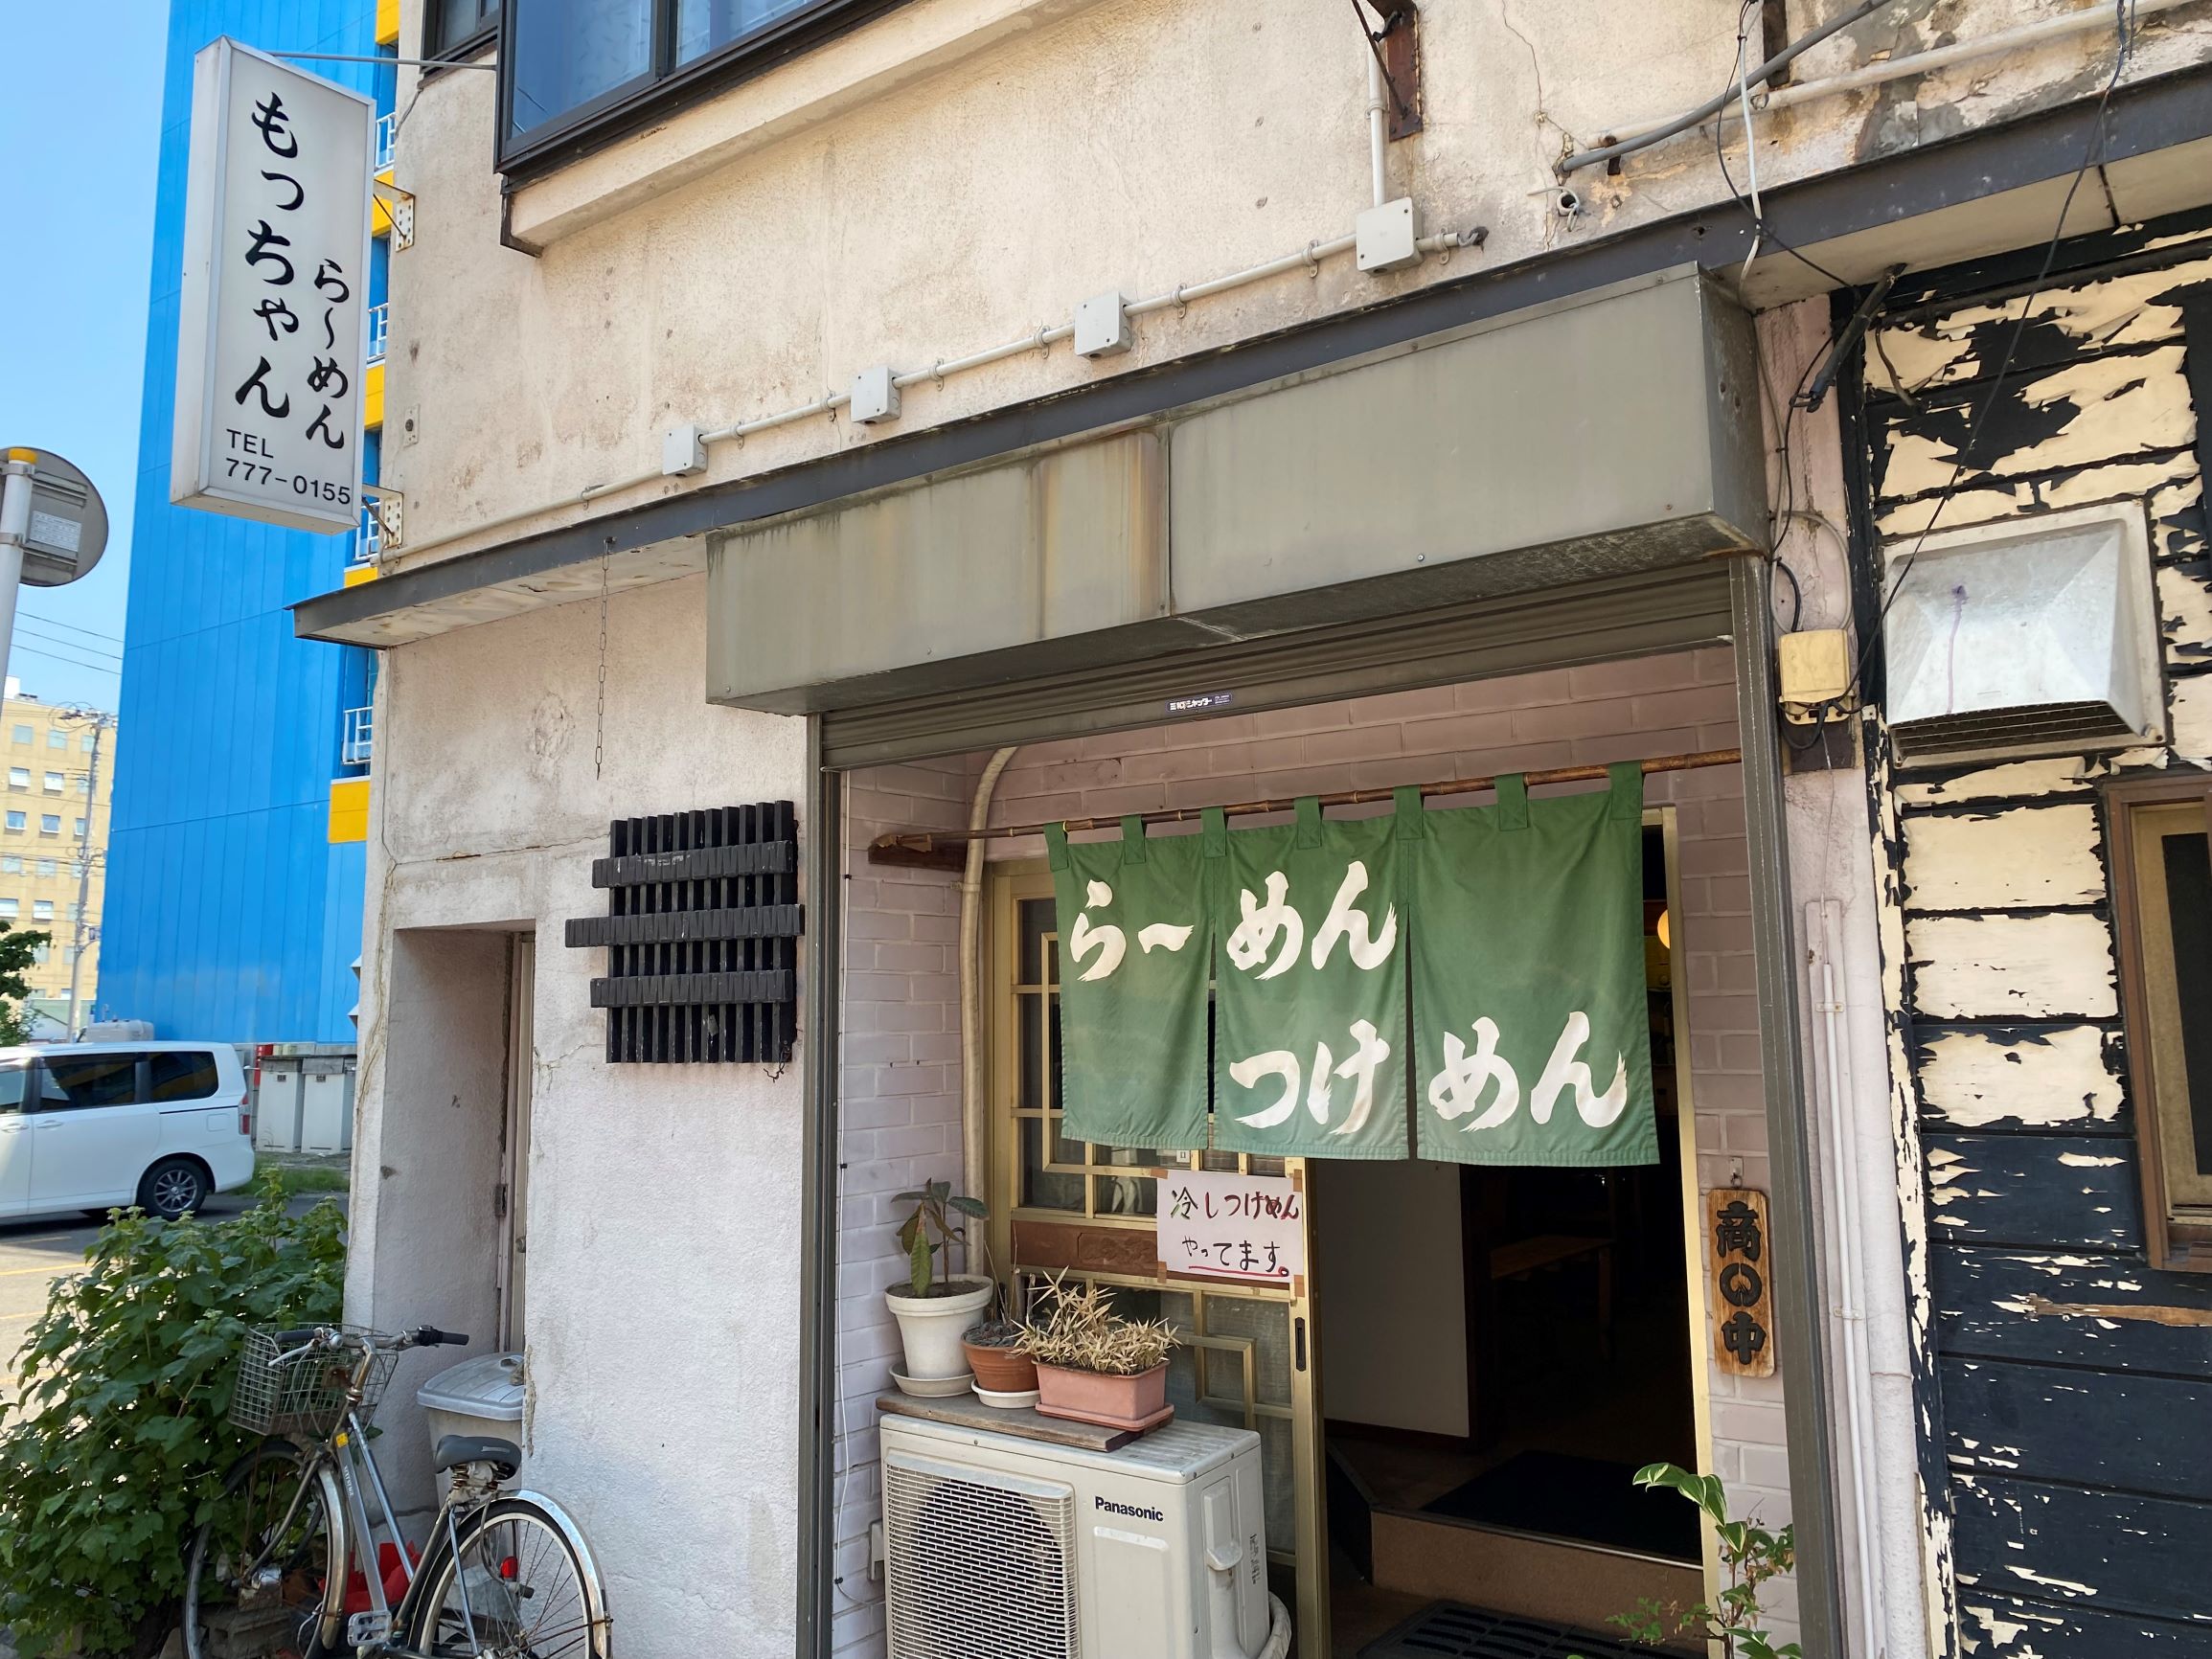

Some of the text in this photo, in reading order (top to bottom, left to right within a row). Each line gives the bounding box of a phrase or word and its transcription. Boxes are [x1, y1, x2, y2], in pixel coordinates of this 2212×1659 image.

[235, 92, 304, 419] もっちゃん
[226, 428, 274, 459] TEL
[226, 457, 351, 505] 777-0155
[1170, 1186, 1299, 1220] 冷しつけめん
[1094, 1495, 1164, 1523] Panasonic
